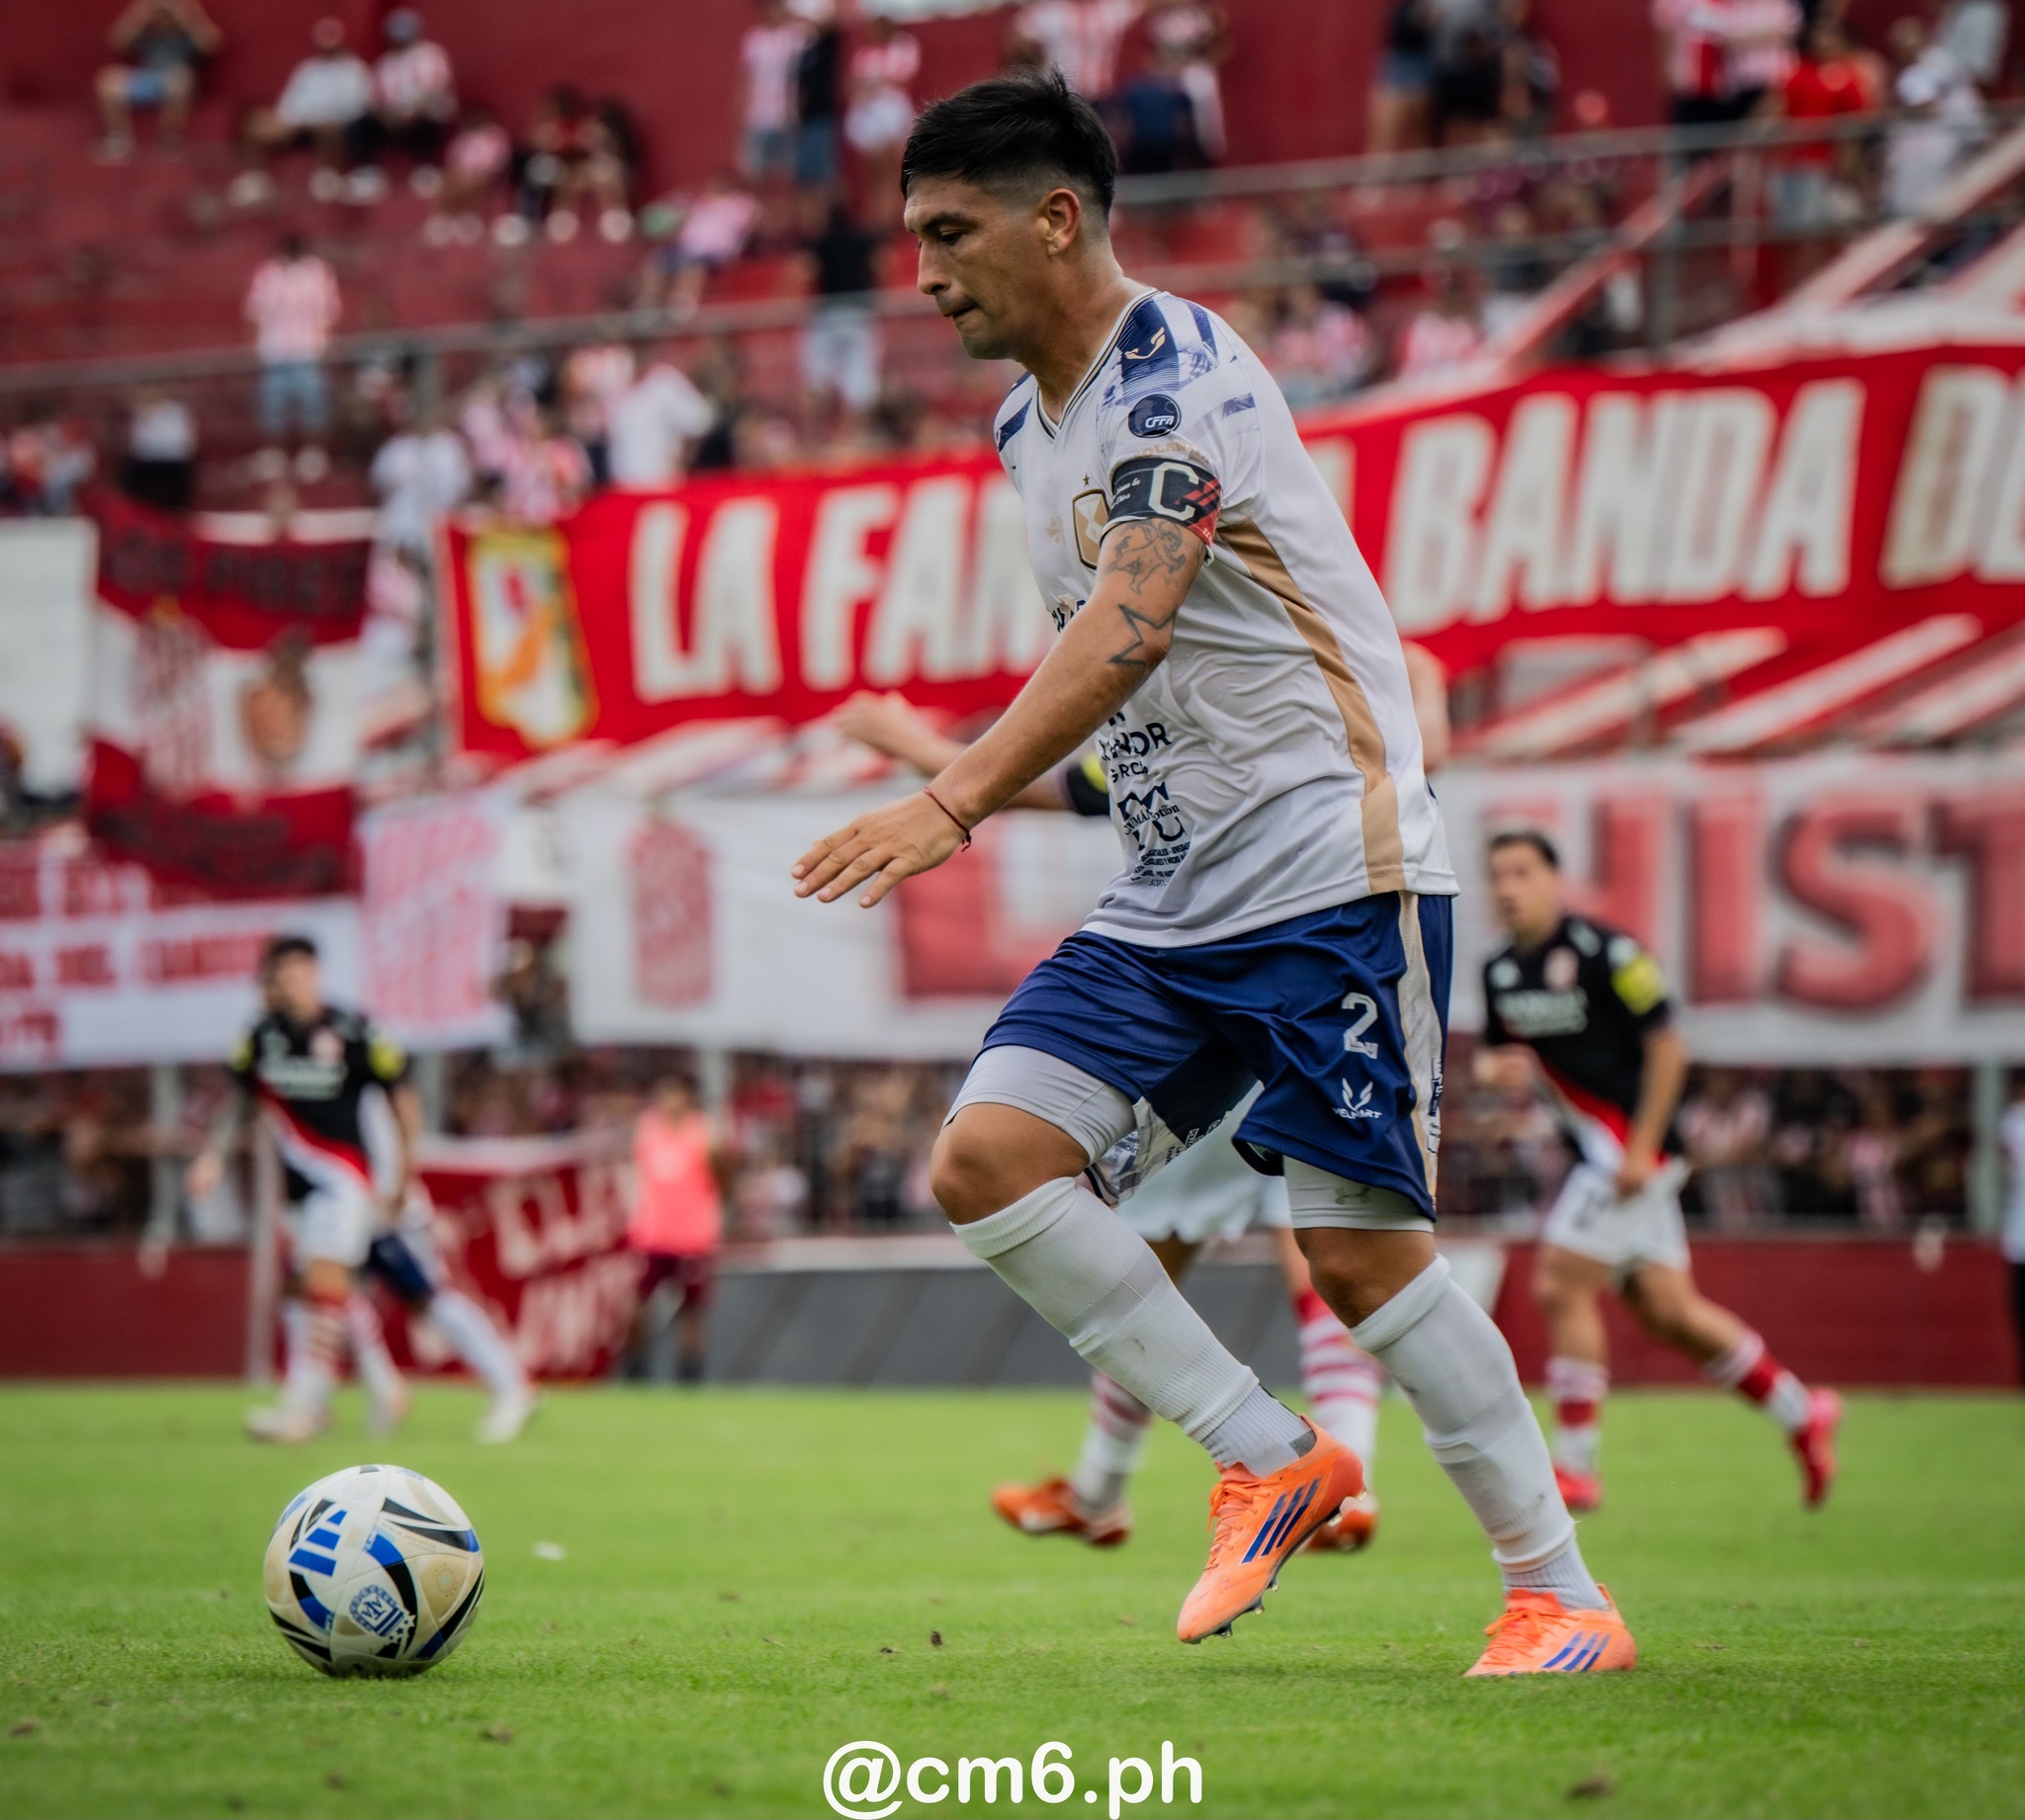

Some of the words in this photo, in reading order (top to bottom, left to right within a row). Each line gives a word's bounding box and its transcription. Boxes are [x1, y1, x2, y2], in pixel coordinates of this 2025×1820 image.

[1148, 461, 1200, 522] C
[628, 494, 783, 704] LA
[1387, 376, 1867, 633] BANDA
[1341, 992, 1379, 1060] 2
